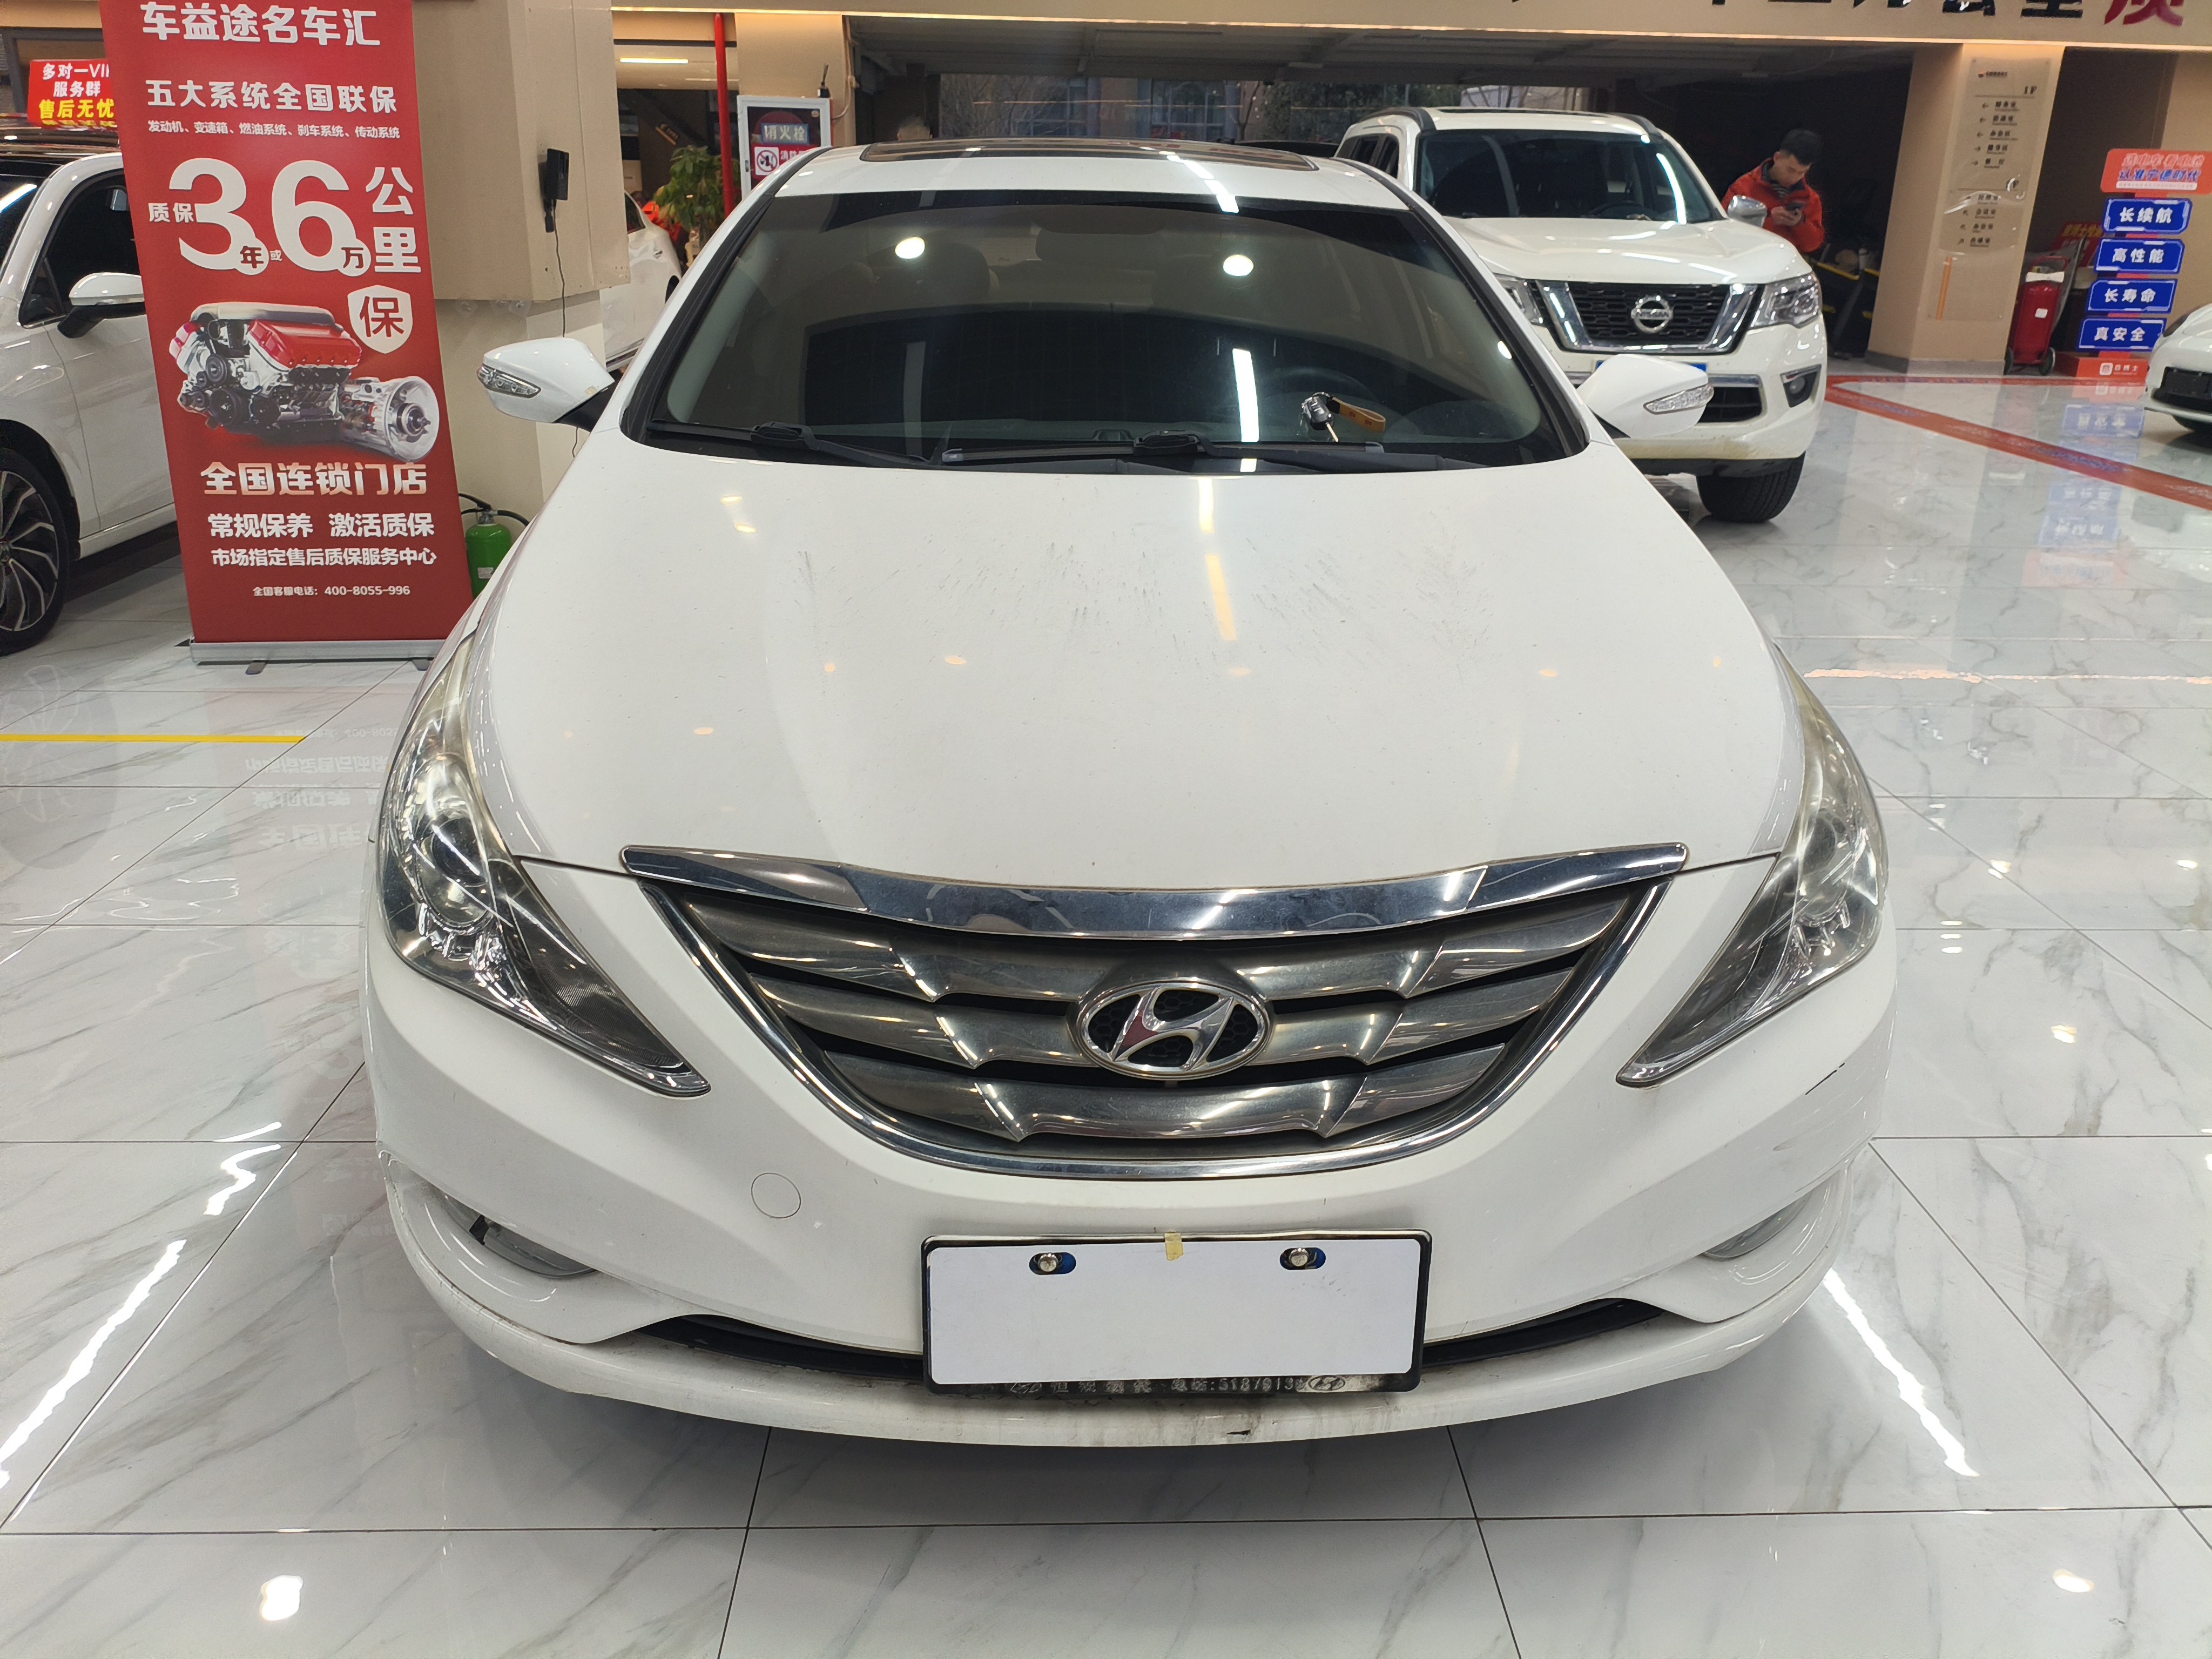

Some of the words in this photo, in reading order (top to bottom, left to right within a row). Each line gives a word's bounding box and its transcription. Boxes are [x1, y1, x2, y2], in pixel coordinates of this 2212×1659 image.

[140, 2, 380, 45] 车益途名车汇
[43, 63, 109, 80] 多对一VI
[53, 80, 101, 98] 服务群
[146, 80, 396, 113] 五大系统全国联保
[38, 98, 114, 119] 售后无忧
[149, 203, 194, 223] 质保
[2119, 207, 2173, 224] 长续航
[2112, 247, 2164, 264] 高性能
[2105, 288, 2156, 303] 长寿命
[359, 295, 404, 338] 保
[2094, 326, 2146, 341] 真安全
[200, 461, 427, 495] 全国连锁门店
[207, 513, 314, 538] 常规保养
[328, 512, 435, 538] 激活质保
[211, 547, 437, 567] 市场指定售后质保服务中心
[324, 585, 410, 596] 400-8055-996
